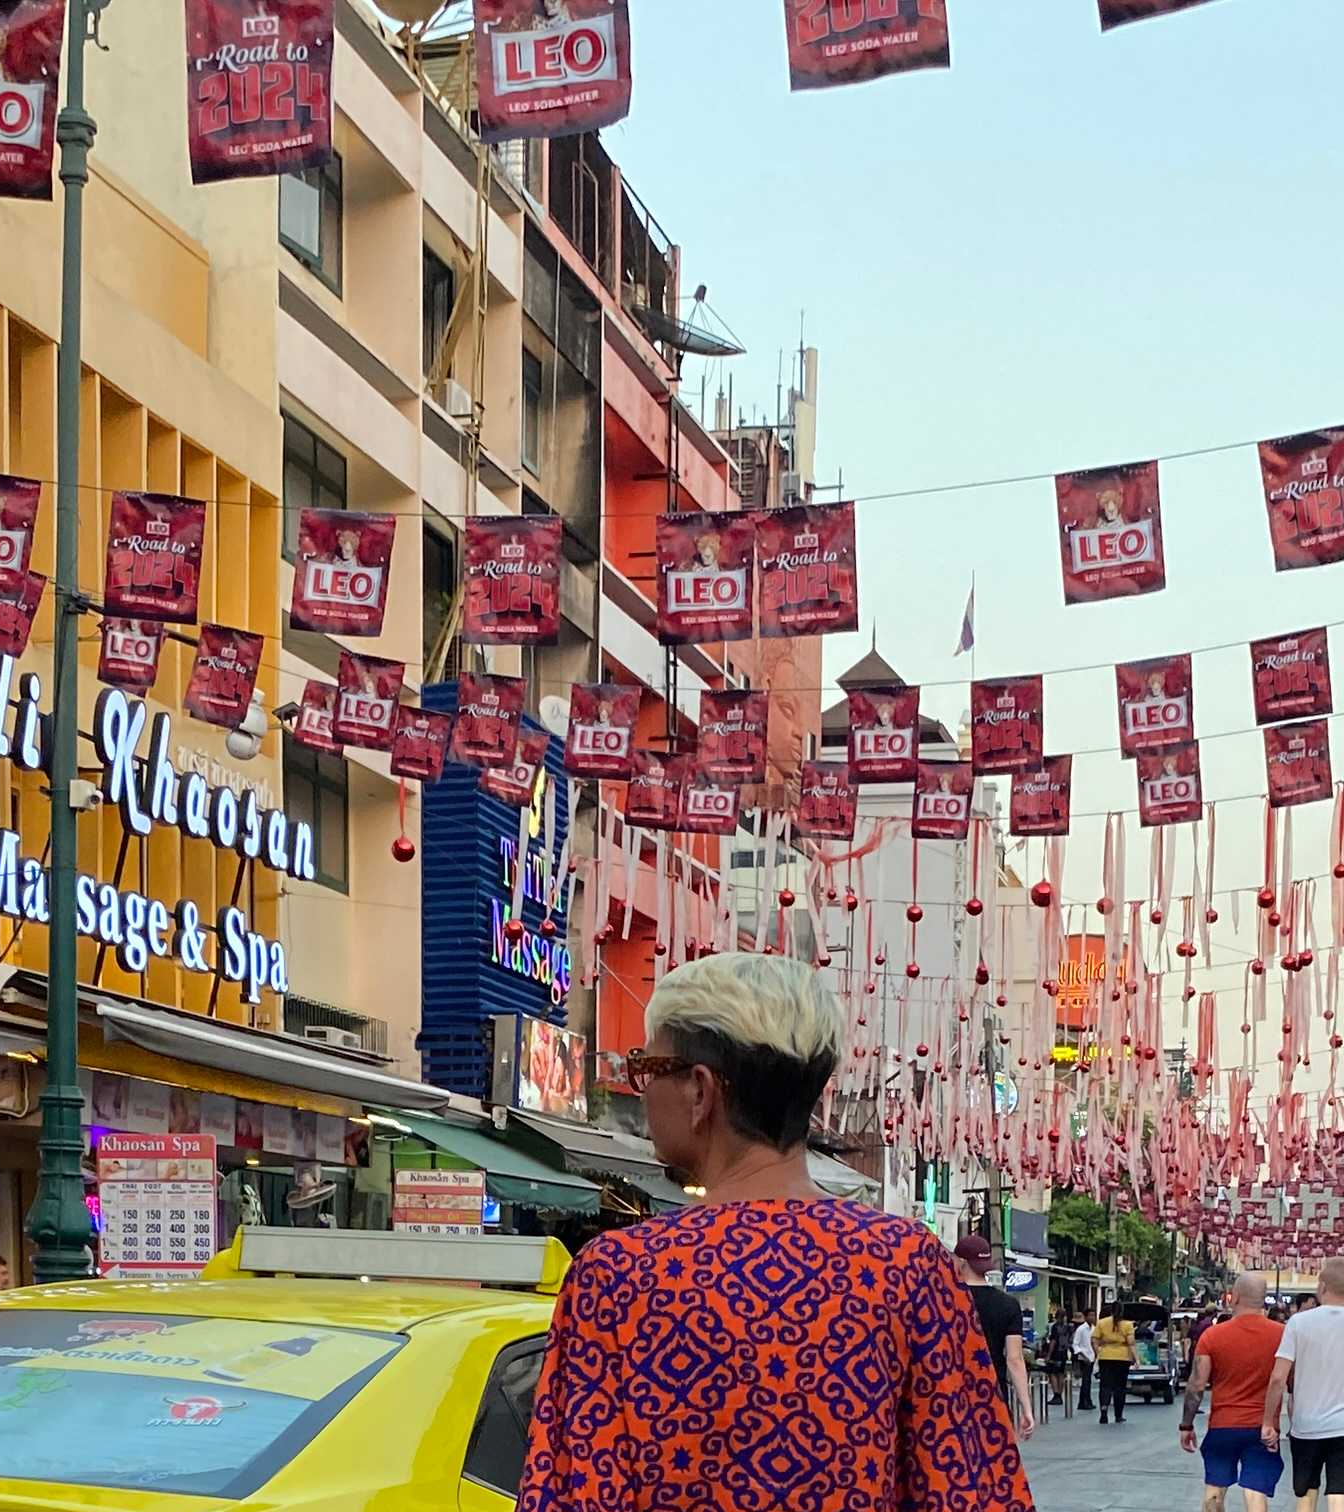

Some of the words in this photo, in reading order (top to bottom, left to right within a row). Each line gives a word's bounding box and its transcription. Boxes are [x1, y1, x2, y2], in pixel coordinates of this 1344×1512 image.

[217, 41, 280, 72] Road
[286, 40, 308, 62] to
[505, 32, 604, 83] LEO
[200, 64, 325, 132] 2024
[1286, 476, 1329, 499] Road
[126, 534, 166, 555] Road
[171, 542, 185, 554] to
[776, 551, 814, 570] Road
[819, 549, 837, 564] to
[1080, 527, 1147, 563] LEO
[112, 551, 193, 596] 2024
[311, 568, 373, 599] LEO
[482, 559, 522, 577] Road
[527, 562, 541, 575] to
[468, 574, 553, 619] 2024
[675, 576, 738, 605] LEO
[763, 564, 853, 607] 2024
[1132, 702, 1178, 727] LEO
[579, 731, 622, 753] LEO
[99, 688, 316, 880] Khaosan
[175, 898, 210, 974] &
[223, 906, 290, 1005] Spa
[100, 1135, 166, 1152] Khaosan
[171, 1136, 202, 1156] Spa
